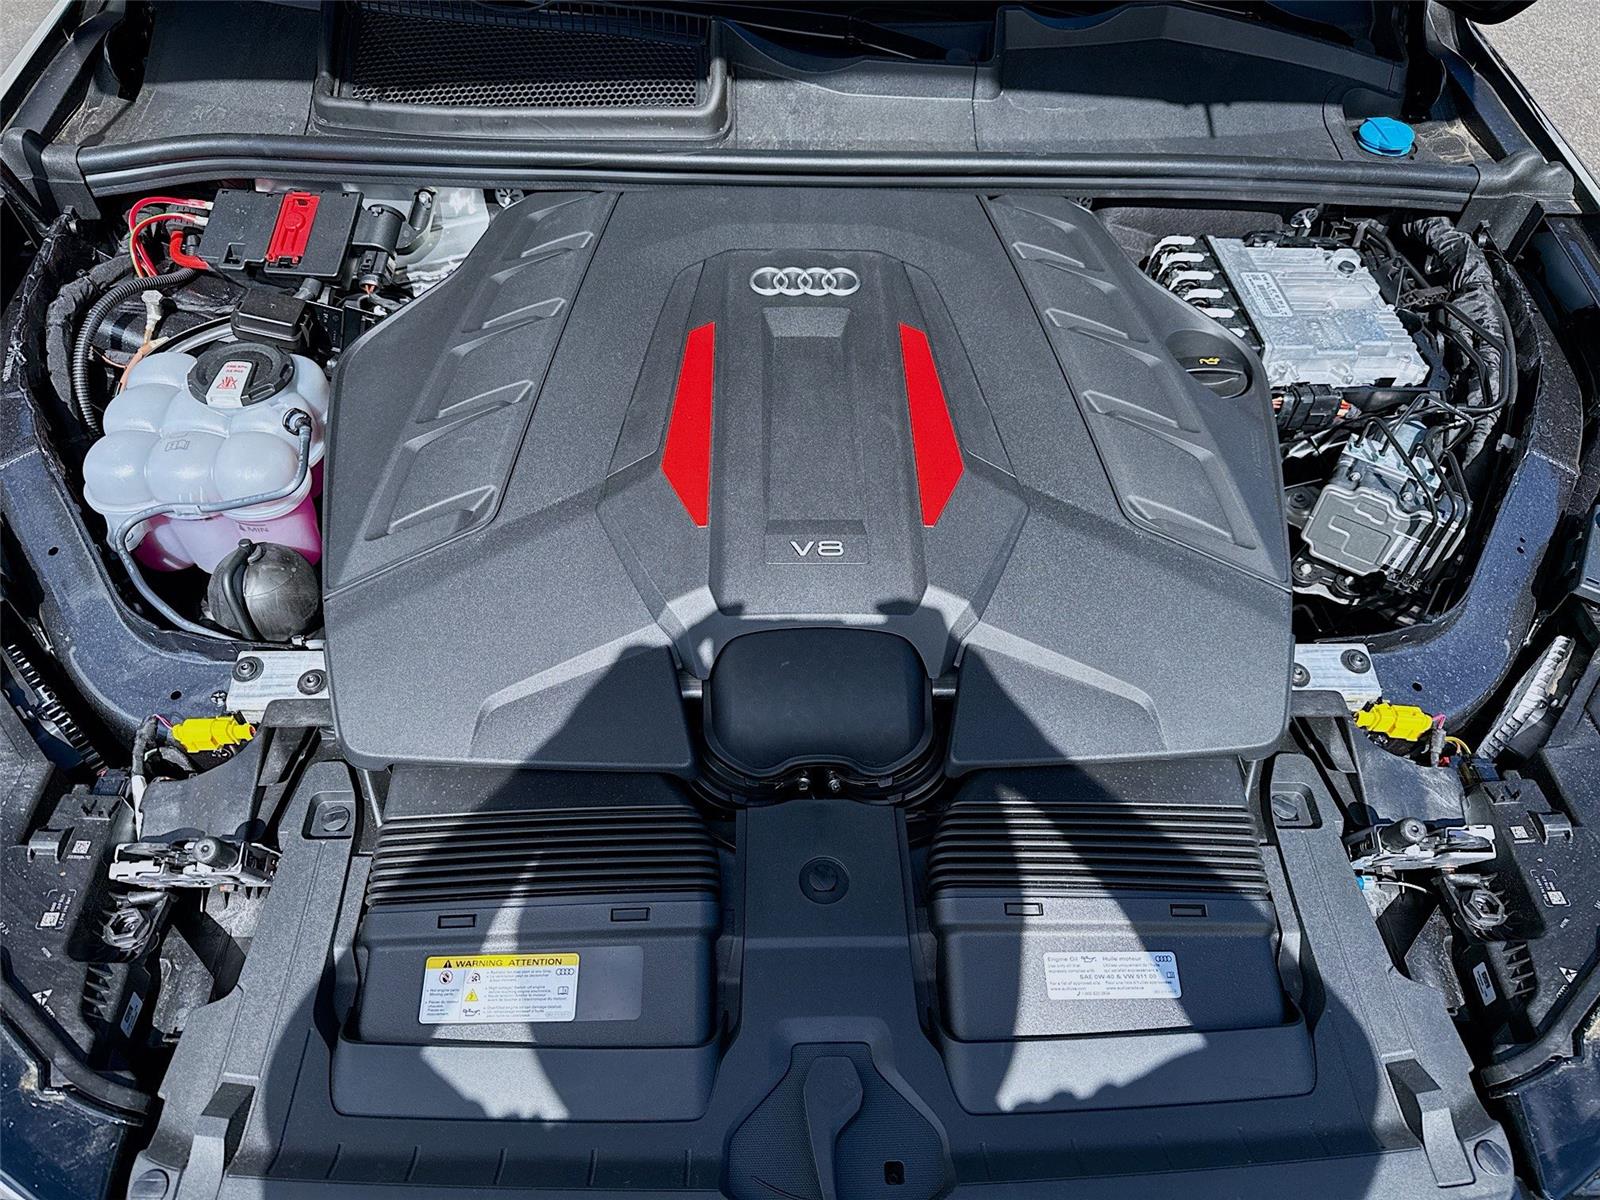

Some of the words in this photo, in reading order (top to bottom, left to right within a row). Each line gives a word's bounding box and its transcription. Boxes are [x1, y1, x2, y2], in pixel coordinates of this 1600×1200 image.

[789, 540, 845, 557] V8
[456, 959, 504, 968] WARNING
[509, 957, 563, 966] ATTENTION
